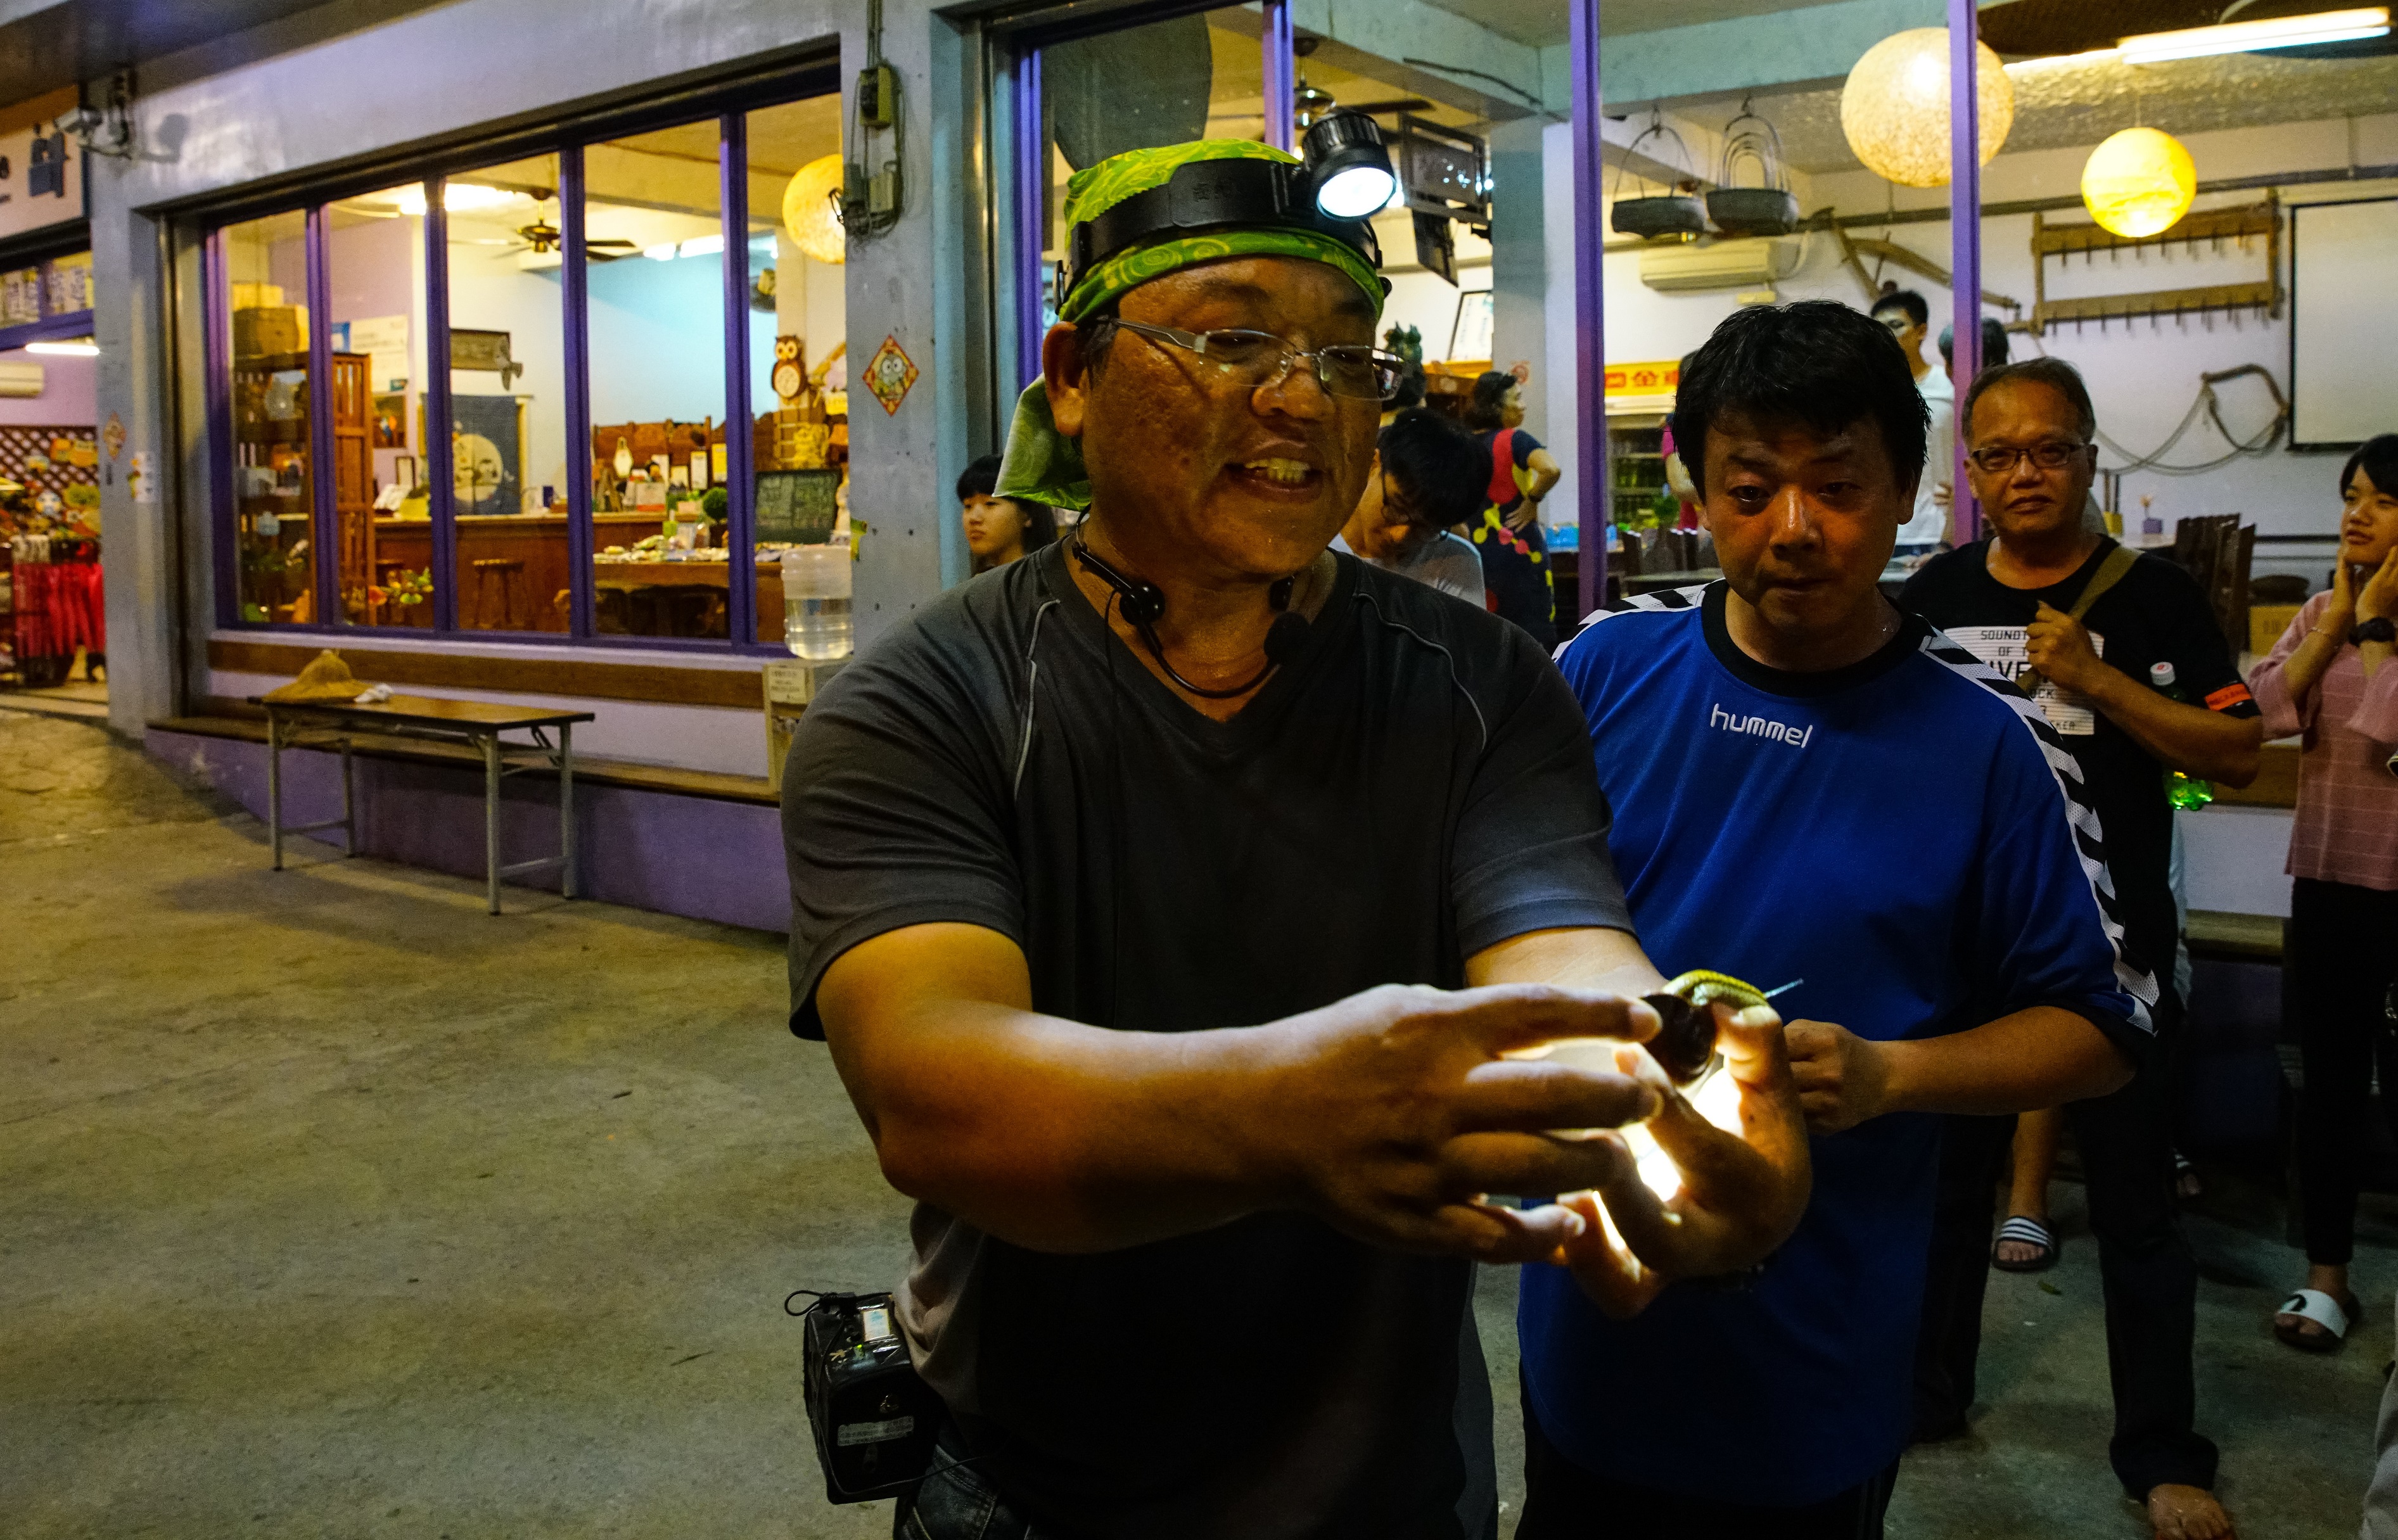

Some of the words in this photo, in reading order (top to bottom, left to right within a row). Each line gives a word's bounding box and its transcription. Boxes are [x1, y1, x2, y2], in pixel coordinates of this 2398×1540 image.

[1980, 630, 2027, 640] SOUNDT
[1998, 646, 2013, 656] OF
[1711, 703, 1813, 748] hummel
